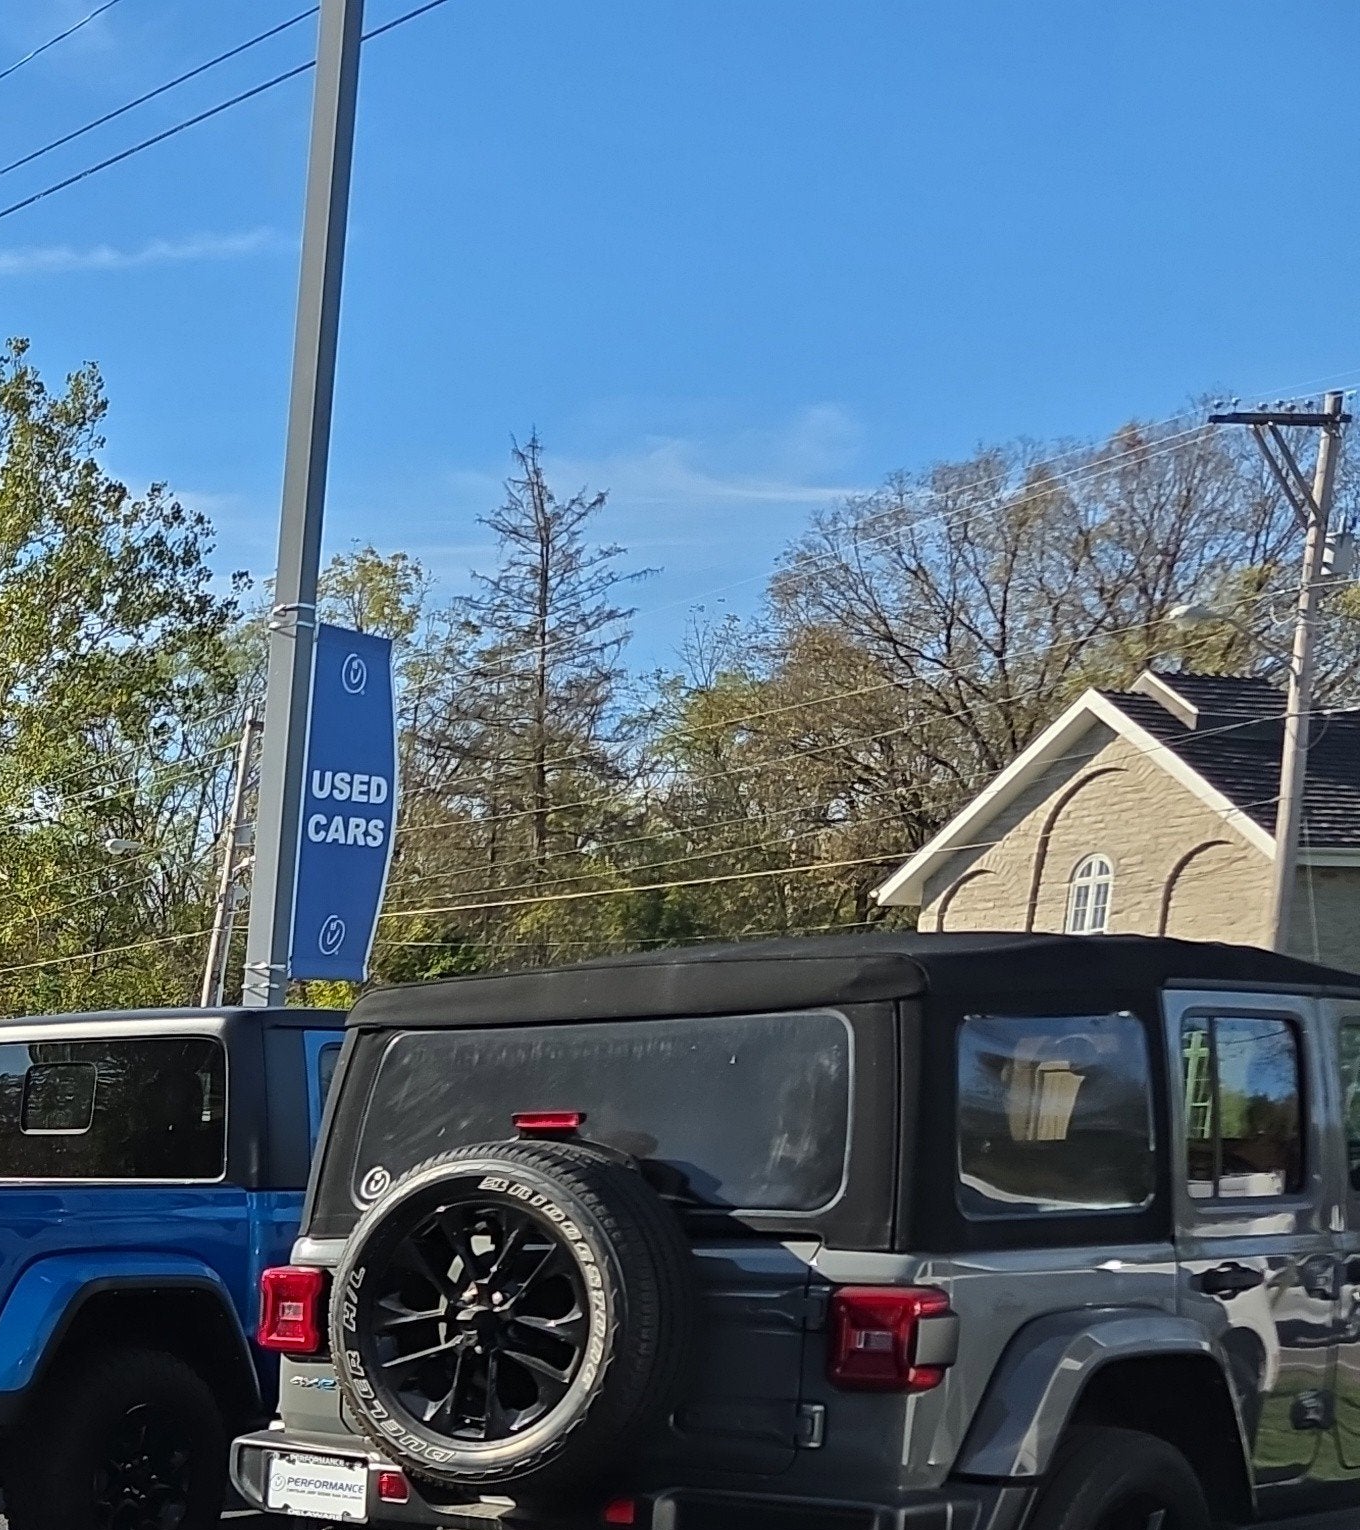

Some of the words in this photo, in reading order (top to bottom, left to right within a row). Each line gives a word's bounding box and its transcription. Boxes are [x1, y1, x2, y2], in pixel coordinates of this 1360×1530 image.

[312, 770, 387, 803] USED
[308, 814, 384, 847] CARS
[343, 1267, 366, 1332] H/L
[478, 1176, 606, 1390] BRIDGESTONE
[346, 1350, 455, 1463] DUELER
[290, 1454, 345, 1467] PERFORMANCE
[287, 1477, 365, 1494] PERFORMANCE
